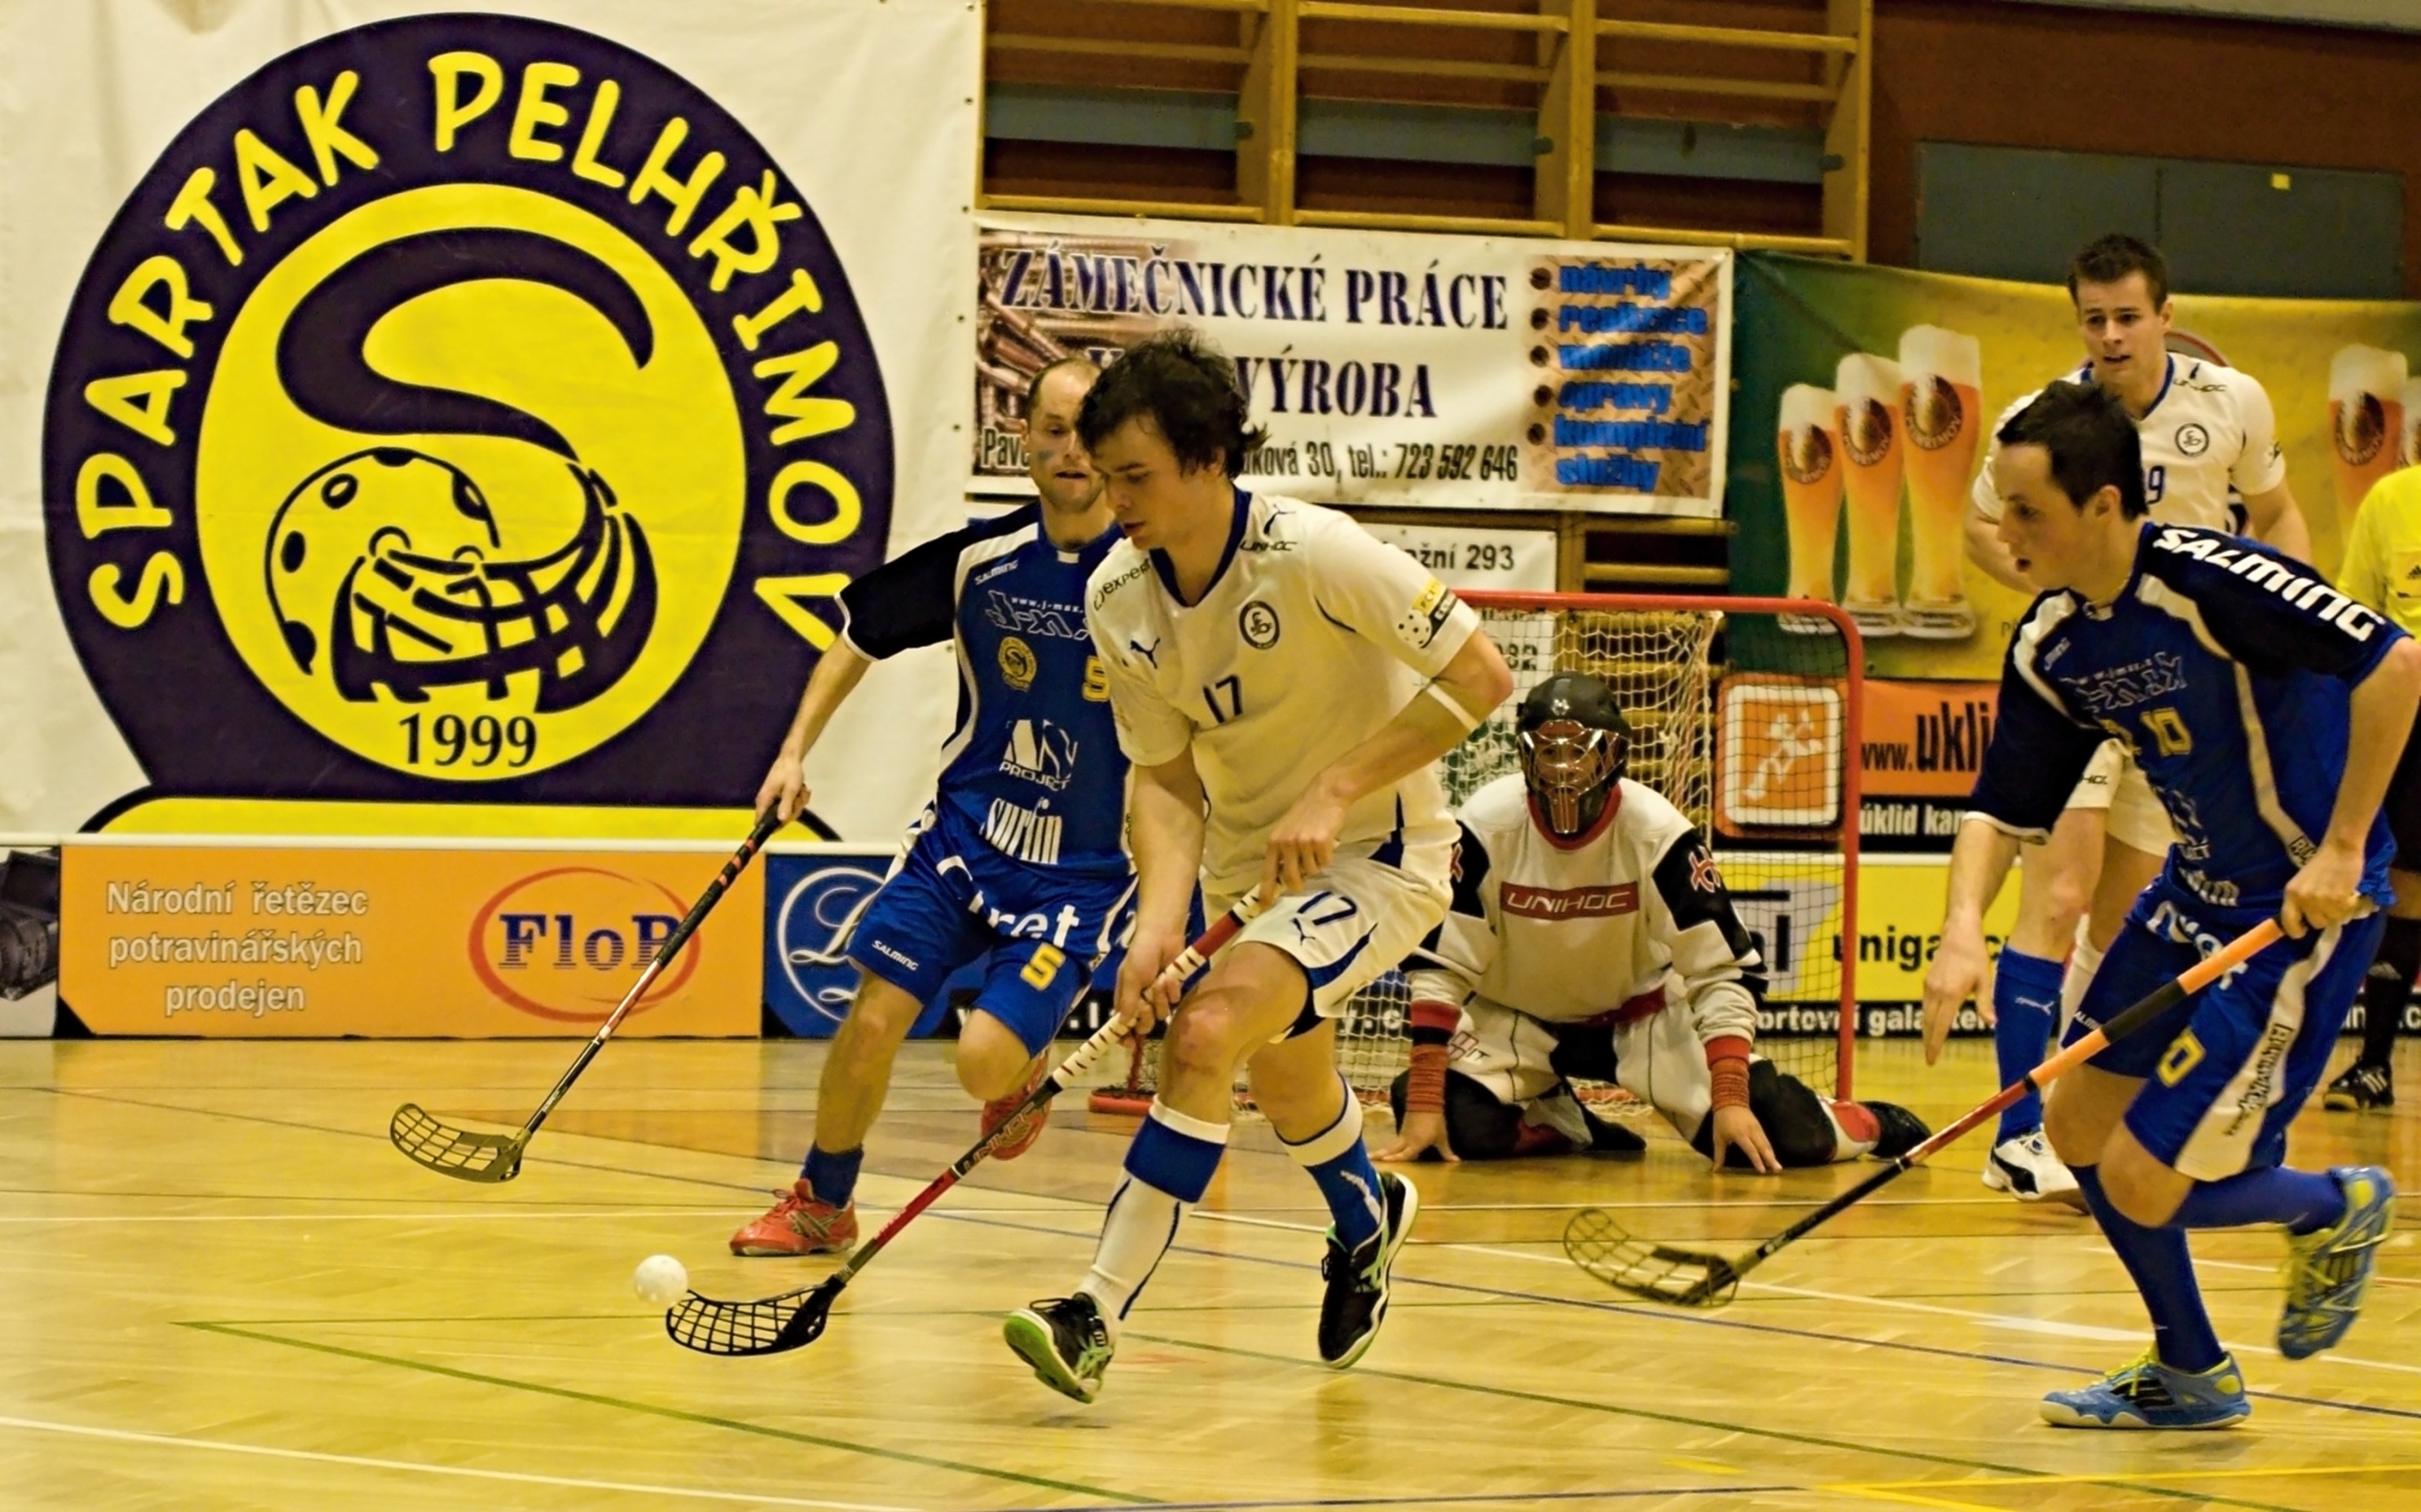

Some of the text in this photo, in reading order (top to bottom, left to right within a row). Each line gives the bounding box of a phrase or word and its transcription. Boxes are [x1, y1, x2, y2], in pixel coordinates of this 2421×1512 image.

[1001, 240, 1509, 331] ZÁMEČNICKÉ PRÁCE
[77, 51, 862, 652] SPARTAK PELHŘIMOV
[1307, 442, 1343, 484] 30,
[1395, 444, 1431, 479] 723
[1437, 444, 1472, 480] 592
[1479, 446, 1518, 481] 646
[1465, 544, 1514, 571] 293
[2152, 528, 2386, 642] SALMING
[1082, 655, 1110, 702] 5
[1202, 674, 1244, 723] 17
[398, 714, 538, 768] 1999
[2139, 706, 2193, 758] 10
[999, 761, 1070, 792] PROJECT
[1859, 802, 1918, 835] úklid
[107, 881, 369, 916] Národní řetězec
[1297, 890, 1358, 927] 17
[1506, 890, 1631, 914] UNIHOC
[109, 930, 362, 970] potravinářských
[871, 939, 919, 972] SALMING
[1020, 942, 1067, 991] 5
[165, 979, 305, 1018] prodejen
